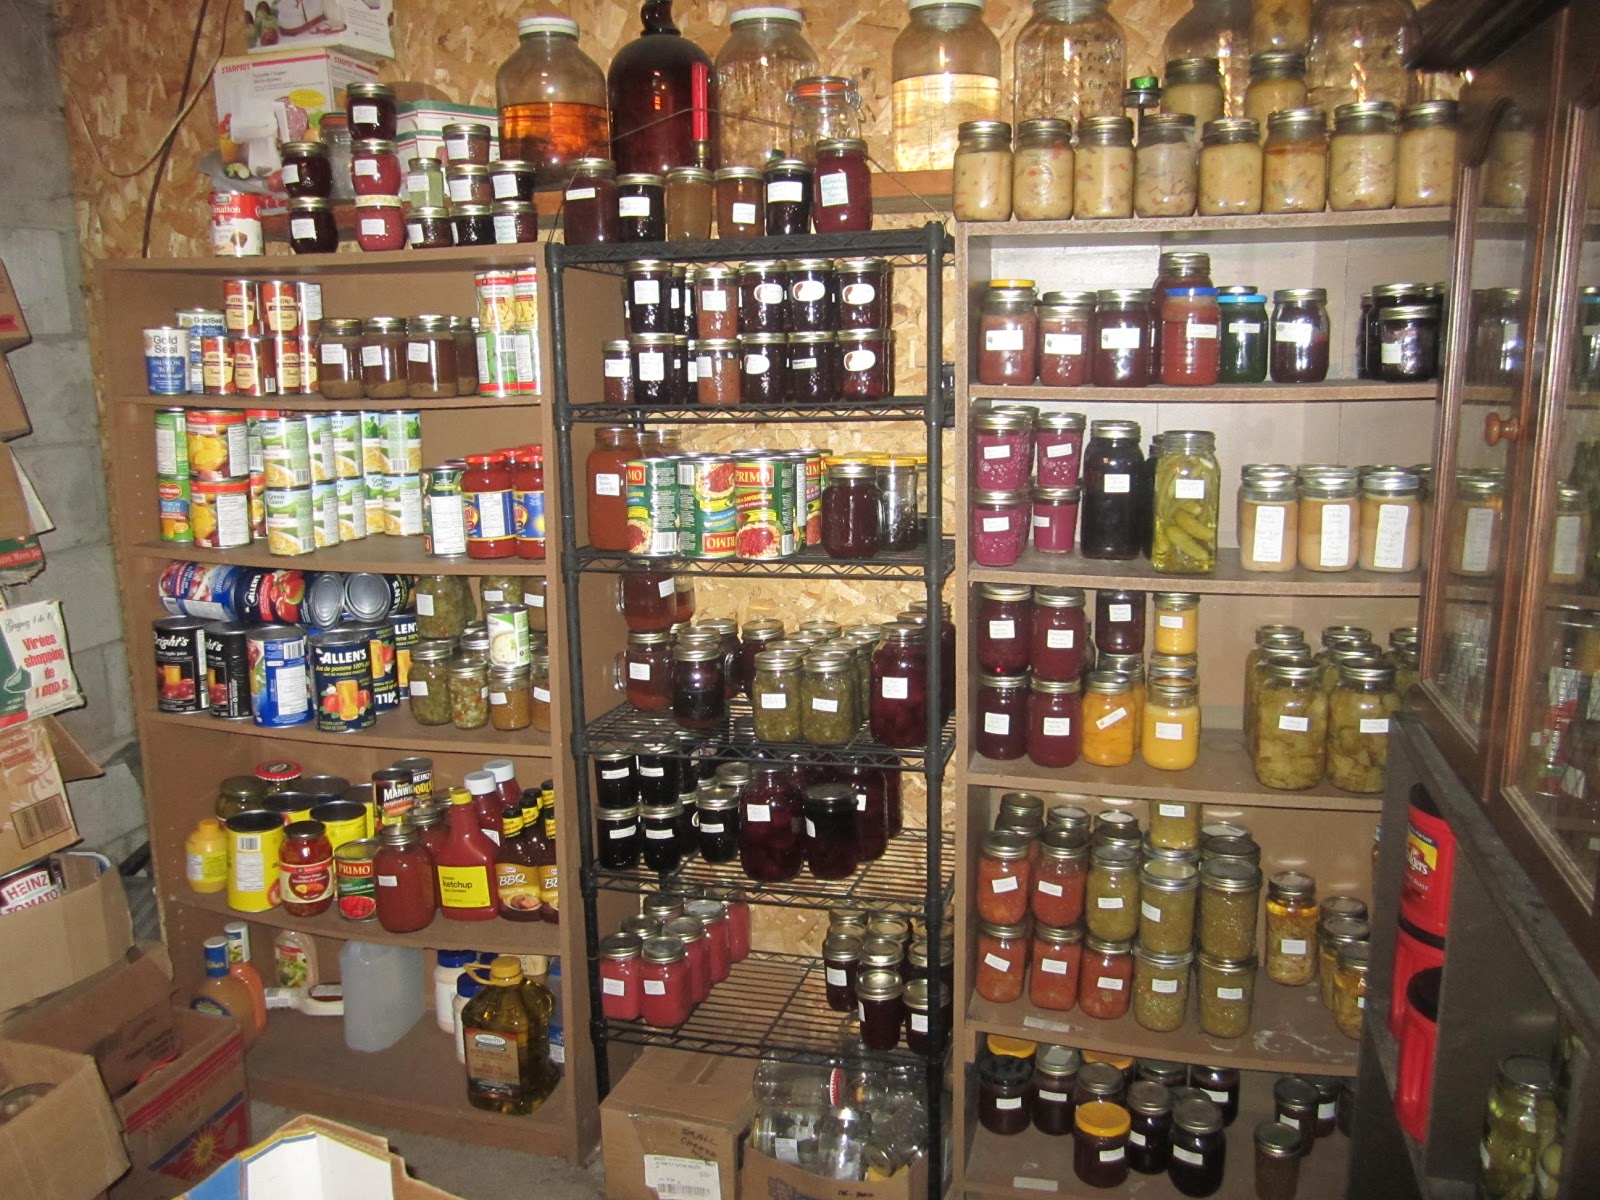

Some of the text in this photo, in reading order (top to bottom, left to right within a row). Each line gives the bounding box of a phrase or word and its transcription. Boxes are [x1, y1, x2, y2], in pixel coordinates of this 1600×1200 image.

[221, 63, 250, 75] STARFRIT
[334, 56, 355, 69] STARFRIT
[212, 205, 241, 214] nation
[153, 336, 178, 345] Gold
[154, 345, 178, 354] Seal
[735, 469, 770, 483] PRIMO
[806, 467, 820, 476] RIM
[706, 536, 736, 548] RIMO
[247, 574, 262, 604] ALLEN'S
[394, 621, 418, 634] LEN'
[22, 634, 57, 651] Virées
[205, 638, 224, 652] ht's
[24, 648, 66, 668] shopping
[319, 648, 367, 665] ALLEN'S
[44, 667, 55, 680] de
[331, 664, 352, 673] pomme
[383, 785, 413, 802] MANWI
[1406, 849, 1428, 876] olgers
[338, 864, 371, 875] PRIMO
[442, 880, 473, 889] ketchup
[499, 873, 528, 886] BBQ
[6, 873, 49, 901] HEINZ
